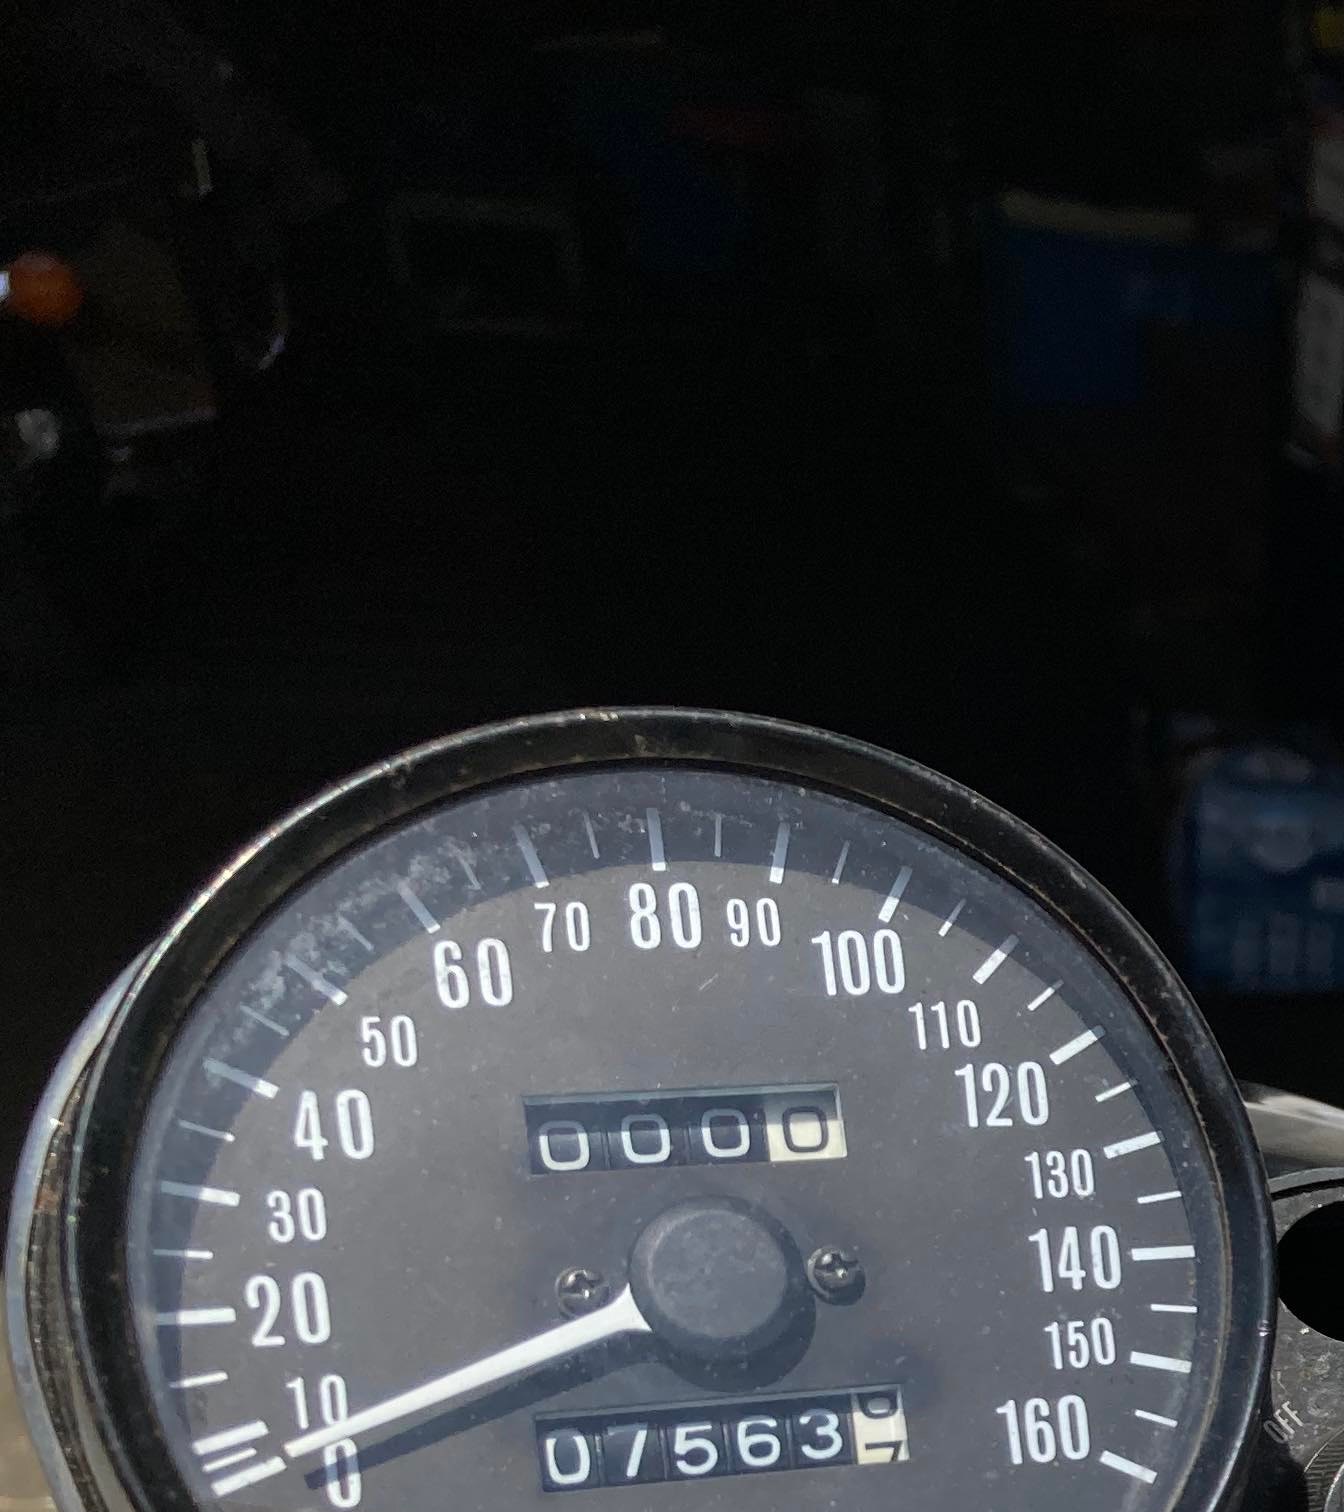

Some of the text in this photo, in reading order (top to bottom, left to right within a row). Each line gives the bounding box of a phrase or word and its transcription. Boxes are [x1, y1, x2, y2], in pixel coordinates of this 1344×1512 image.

[534, 901, 590, 952] 70
[629, 882, 701, 949] 80
[727, 898, 780, 947] 90
[433, 938, 512, 1008] 60
[811, 929, 905, 996] 100
[360, 1015, 417, 1067] 50
[908, 1000, 980, 1050] 110
[293, 1089, 374, 1160] 40
[955, 1062, 1048, 1127] 120
[538, 1109, 828, 1172] 0000
[1025, 1149, 1093, 1198] 130
[267, 1188, 326, 1243] 30
[1029, 1226, 1120, 1292] 140
[245, 1272, 330, 1347] 20
[1045, 1318, 1115, 1369] 150
[284, 1374, 350, 1429] 10
[996, 1395, 1089, 1464] 160
[1263, 1400, 1304, 1444] OFF
[322, 1437, 366, 1508] 0
